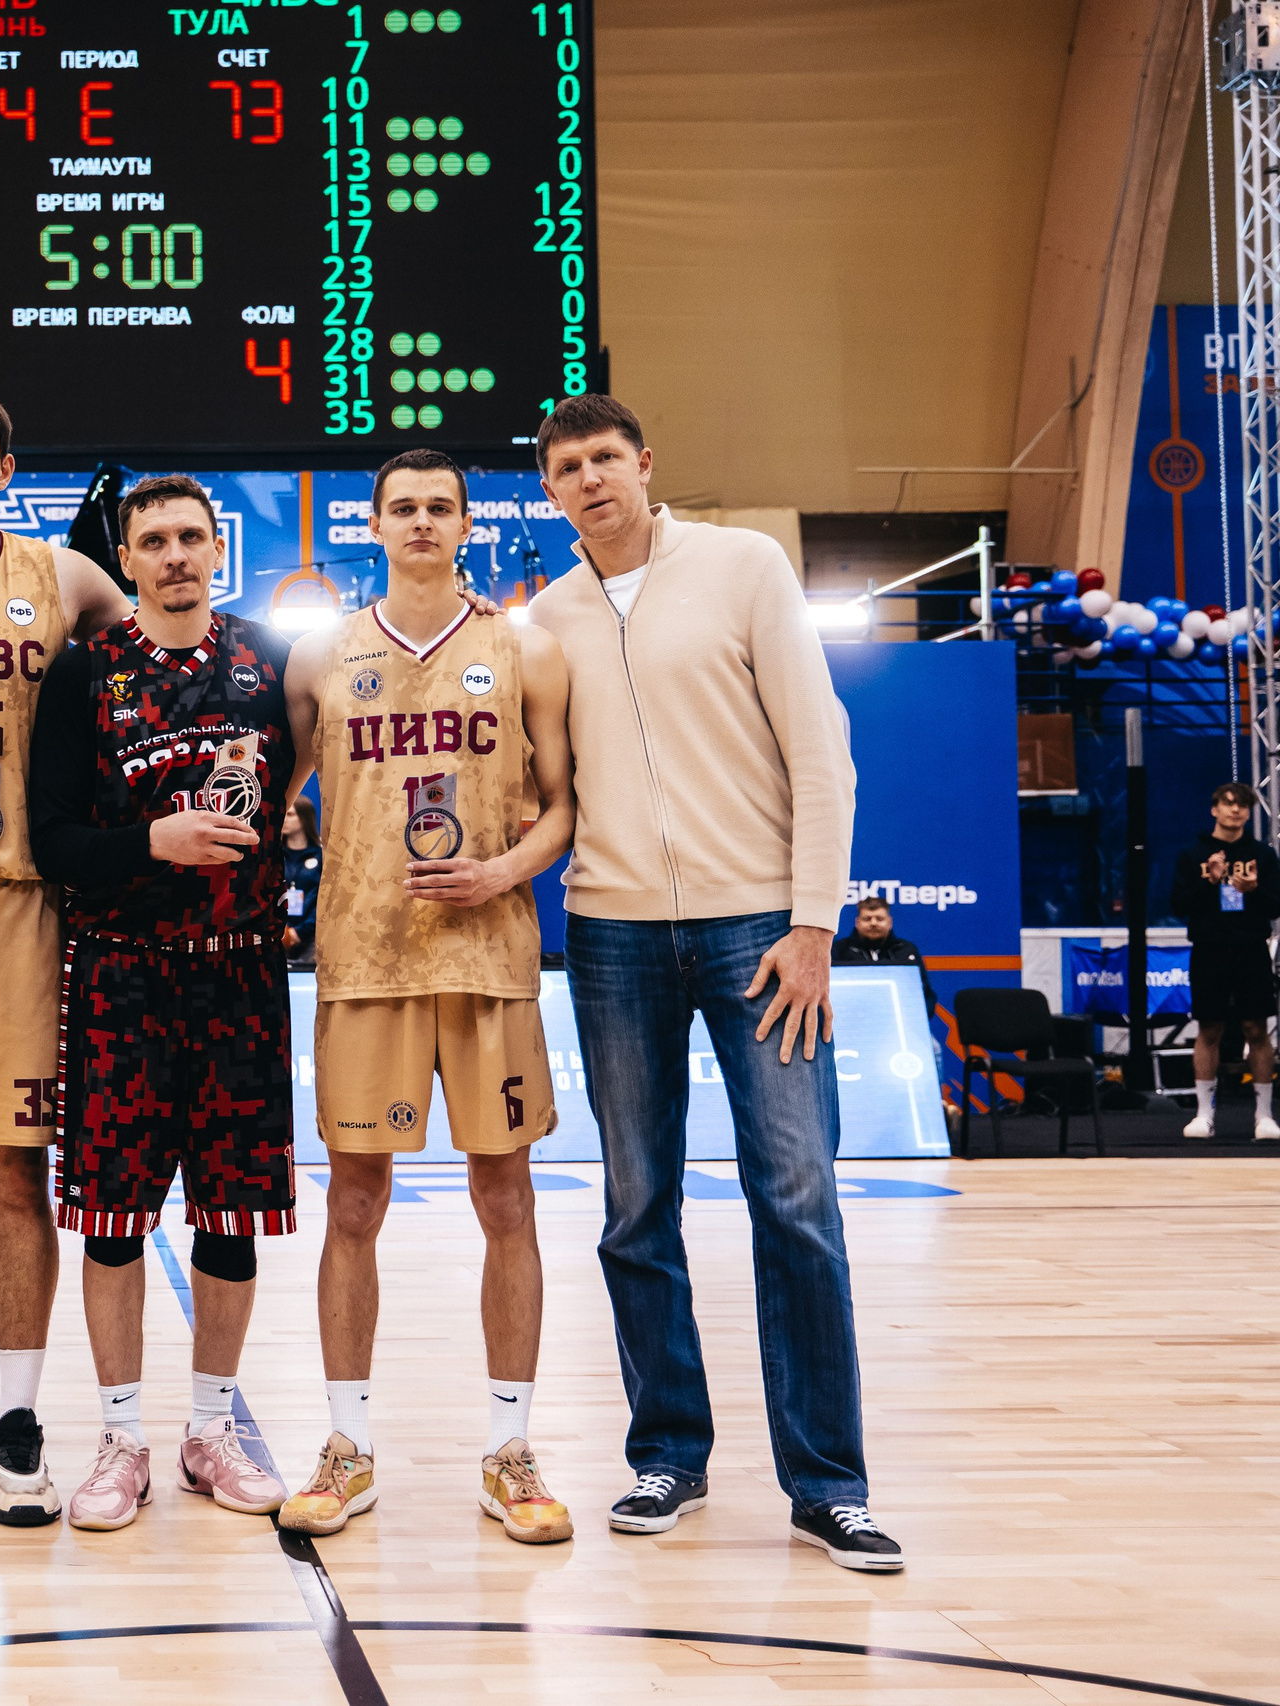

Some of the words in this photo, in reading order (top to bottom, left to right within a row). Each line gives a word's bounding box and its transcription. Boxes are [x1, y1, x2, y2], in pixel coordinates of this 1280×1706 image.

[168, 9, 249, 35] ТУЛА
[347, 5, 363, 38] 1
[532, 3, 573, 36] 11
[60, 50, 138, 69] ПЕРИОД
[217, 49, 269, 68] СЧЕТ
[345, 41, 369, 74] 7
[557, 39, 579, 73] 0
[322, 76, 369, 110] 10
[558, 74, 580, 108] 0
[209, 80, 283, 144] 73
[322, 112, 364, 146] 11
[558, 110, 581, 144] 2
[50, 157, 151, 176] ТАЙМАУТЫ
[323, 148, 371, 182] 13
[559, 146, 581, 180] 0
[36, 193, 101, 213] ВРЕМЯ
[112, 193, 165, 212] ИГРЫ
[323, 184, 371, 217] 15
[534, 182, 582, 216] 12
[324, 219, 372, 253] 17
[533, 218, 583, 252] 22
[39, 223, 204, 291] 5:00
[322, 255, 373, 289] 23
[562, 253, 584, 287] 0
[12, 307, 77, 327] ВРЕМЯ
[88, 306, 192, 326] ПЕРЕРЫВА
[241, 305, 295, 325] ФОЛЫ
[323, 291, 374, 325] 27
[562, 290, 585, 323] 0
[323, 327, 374, 362] 28
[563, 326, 585, 360] 5
[245, 338, 291, 404] 4
[324, 364, 369, 398] 31
[564, 362, 587, 396] 8
[324, 400, 375, 434] 35
[328, 500, 372, 519] СРЕ
[328, 526, 374, 544] СЕЗ
[10, 605, 33, 617] РФБ
[235, 672, 257, 683] РФБ
[465, 674, 491, 685] РФБ
[113, 707, 139, 722] STK
[347, 709, 498, 763] ЦИВС
[13, 1078, 58, 1127] 35
